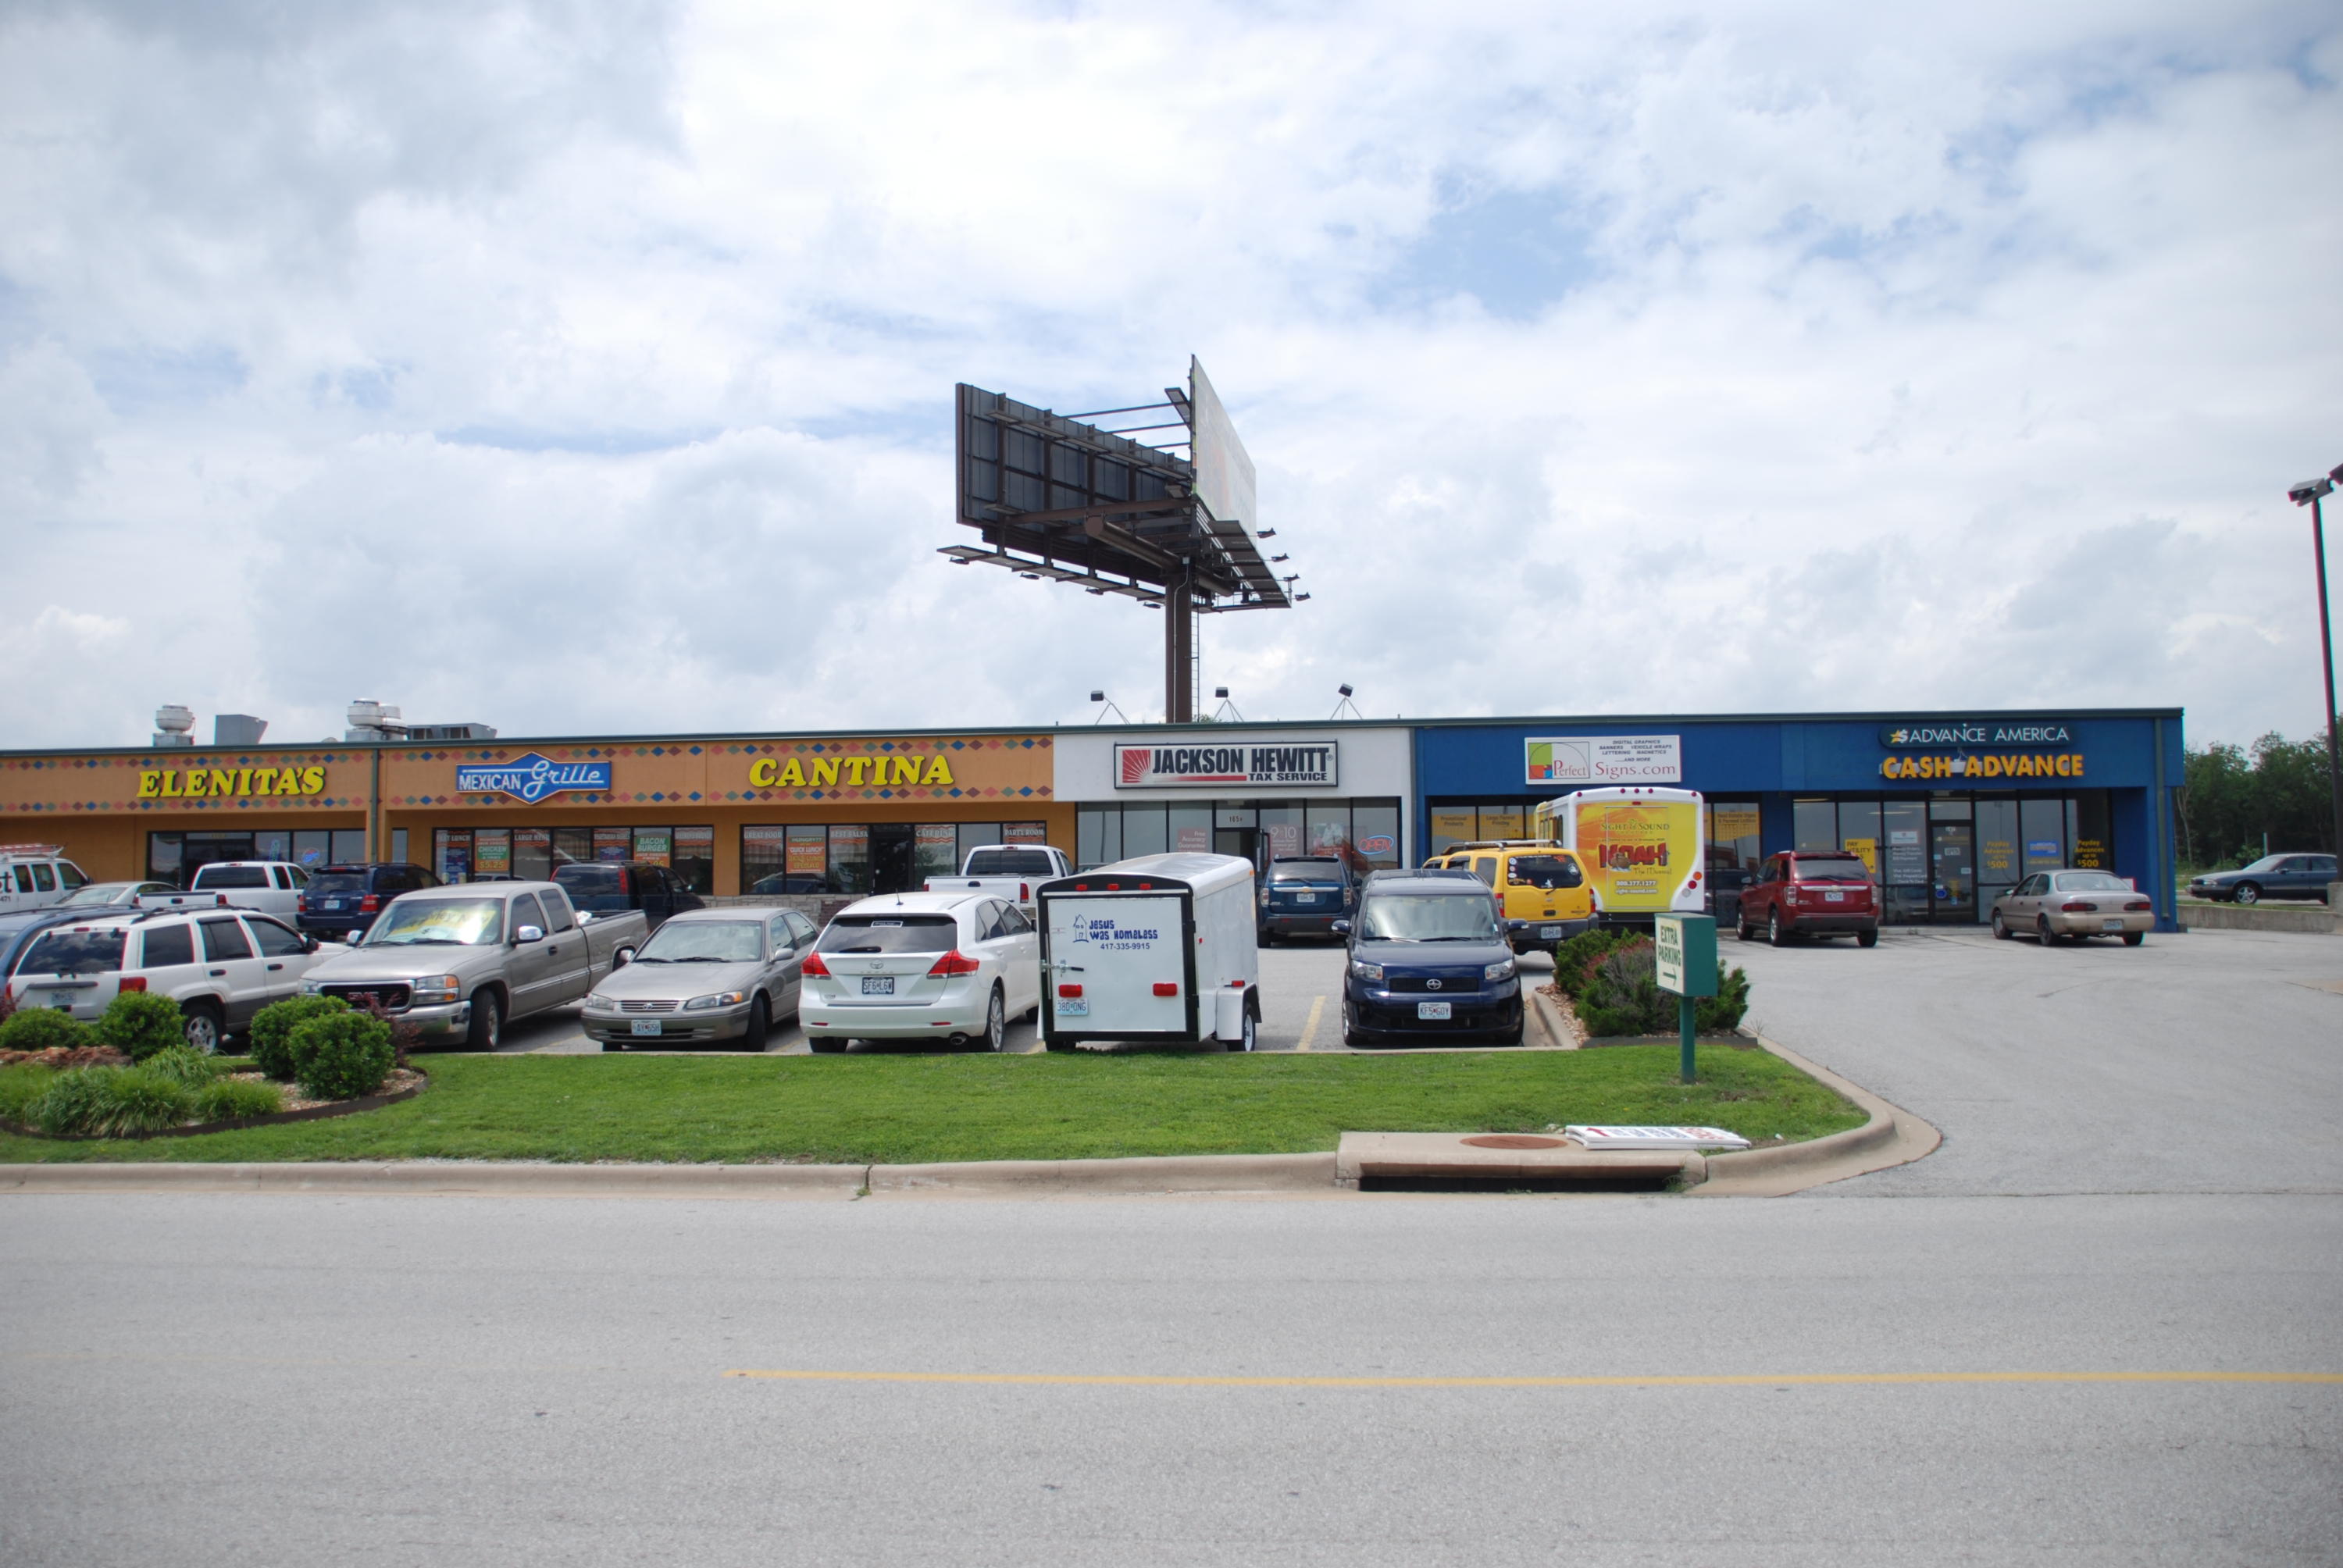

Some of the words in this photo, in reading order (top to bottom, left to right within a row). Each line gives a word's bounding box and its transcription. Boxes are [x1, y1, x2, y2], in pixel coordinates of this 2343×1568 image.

[1909, 728, 1986, 743] ADVANCE
[1994, 727, 2070, 741] AMERICA
[748, 755, 954, 787] CANTINA
[1152, 748, 1244, 774] JACKSON
[1553, 760, 1587, 776] Perfect
[1595, 761, 1676, 780] Signs.com
[1882, 757, 1951, 779] CASH
[1964, 754, 2084, 778] ADVANCE
[137, 766, 325, 798] ELENITA'S
[458, 774, 522, 791] MEXICAN
[522, 760, 604, 798] Grille
[1248, 773, 1273, 782] TAX
[1277, 772, 1328, 781] SERVICE
[1358, 838, 1392, 851] OPEN
[1598, 843, 1668, 868] NOAH
[2077, 859, 2099, 868] $500
[1660, 925, 1678, 946] EXTRA
[1657, 944, 1681, 967] PARKING
